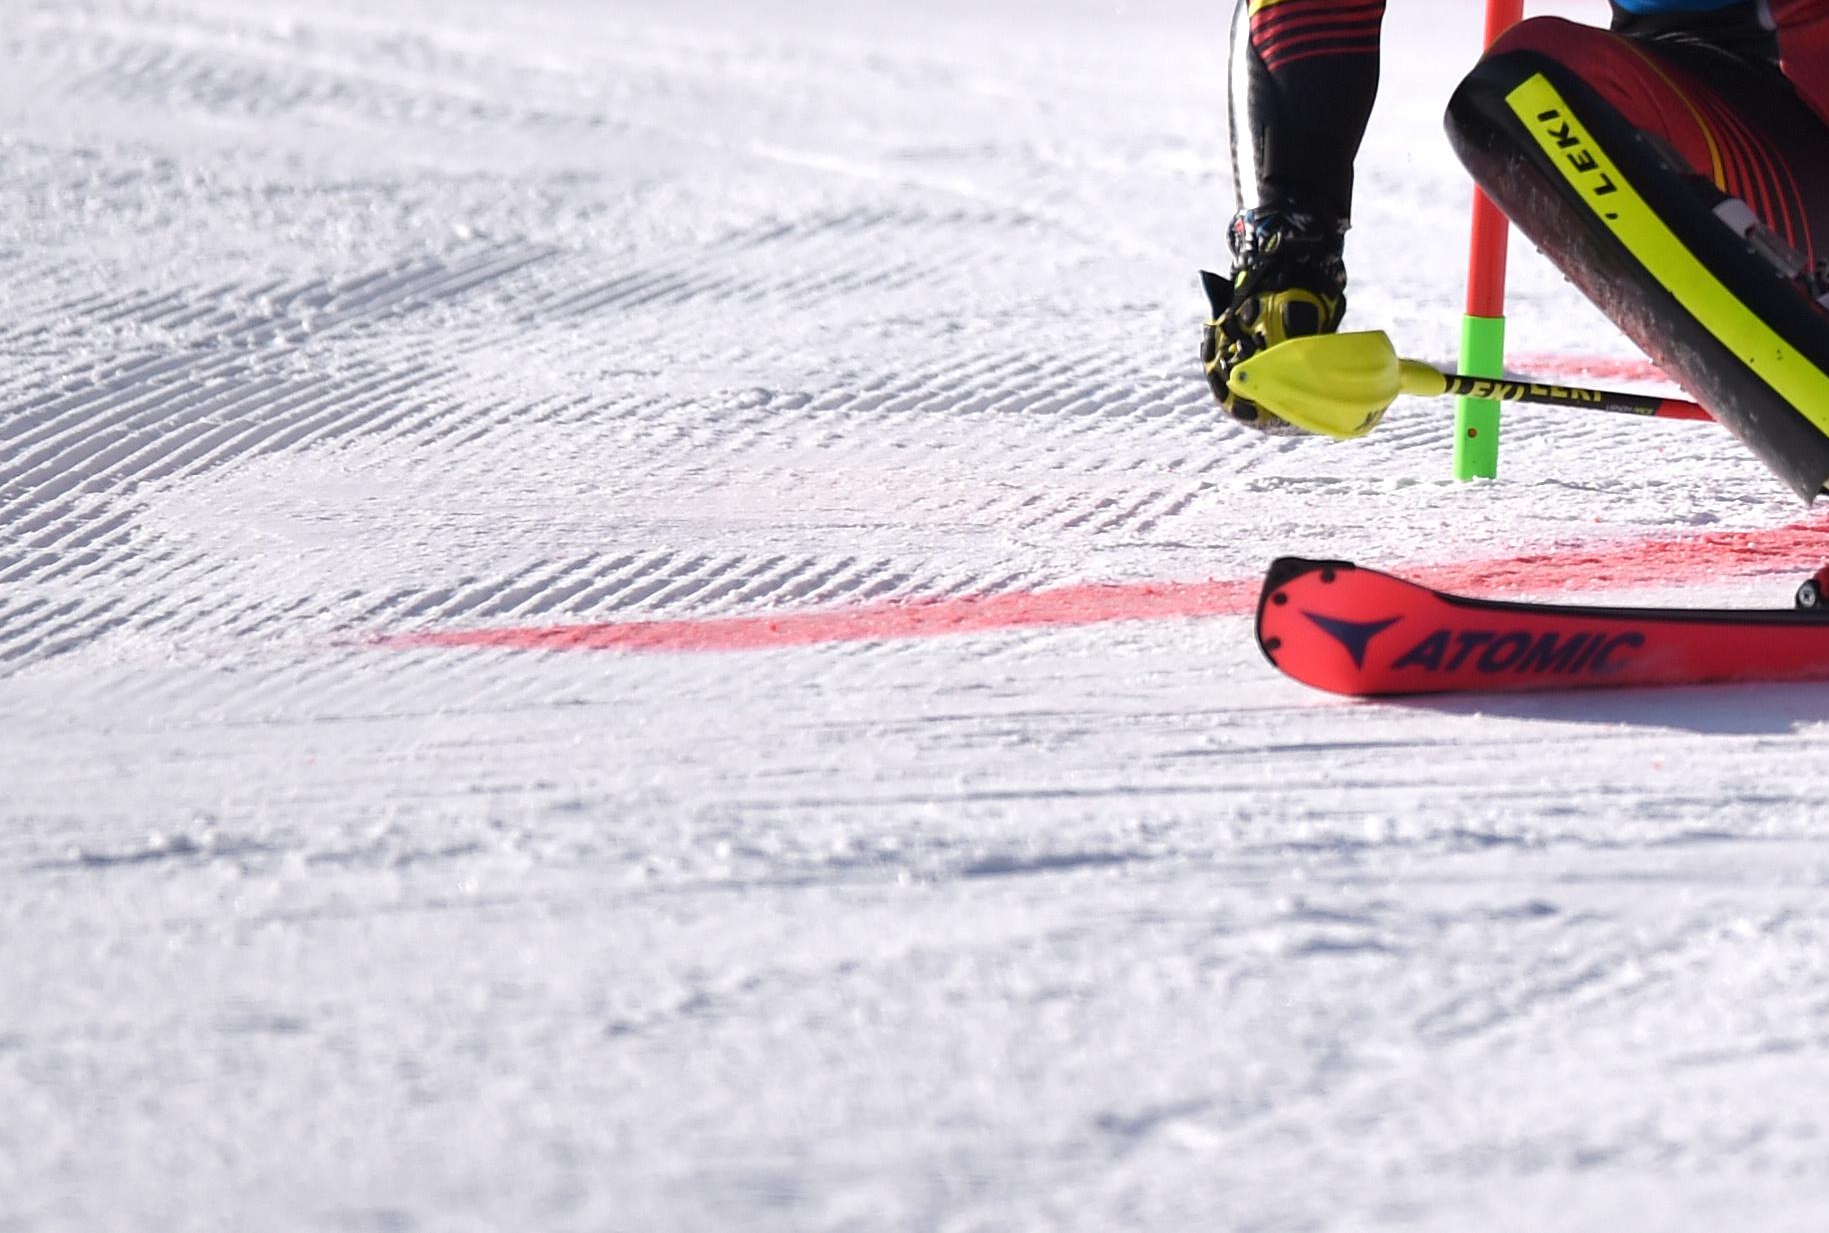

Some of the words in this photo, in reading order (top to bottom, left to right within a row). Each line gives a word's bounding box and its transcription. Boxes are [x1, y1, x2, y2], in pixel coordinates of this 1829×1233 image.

[1537, 109, 1618, 196] LEKI
[1449, 377, 1525, 402] LEKI
[1391, 629, 1646, 674] ATOMIC
